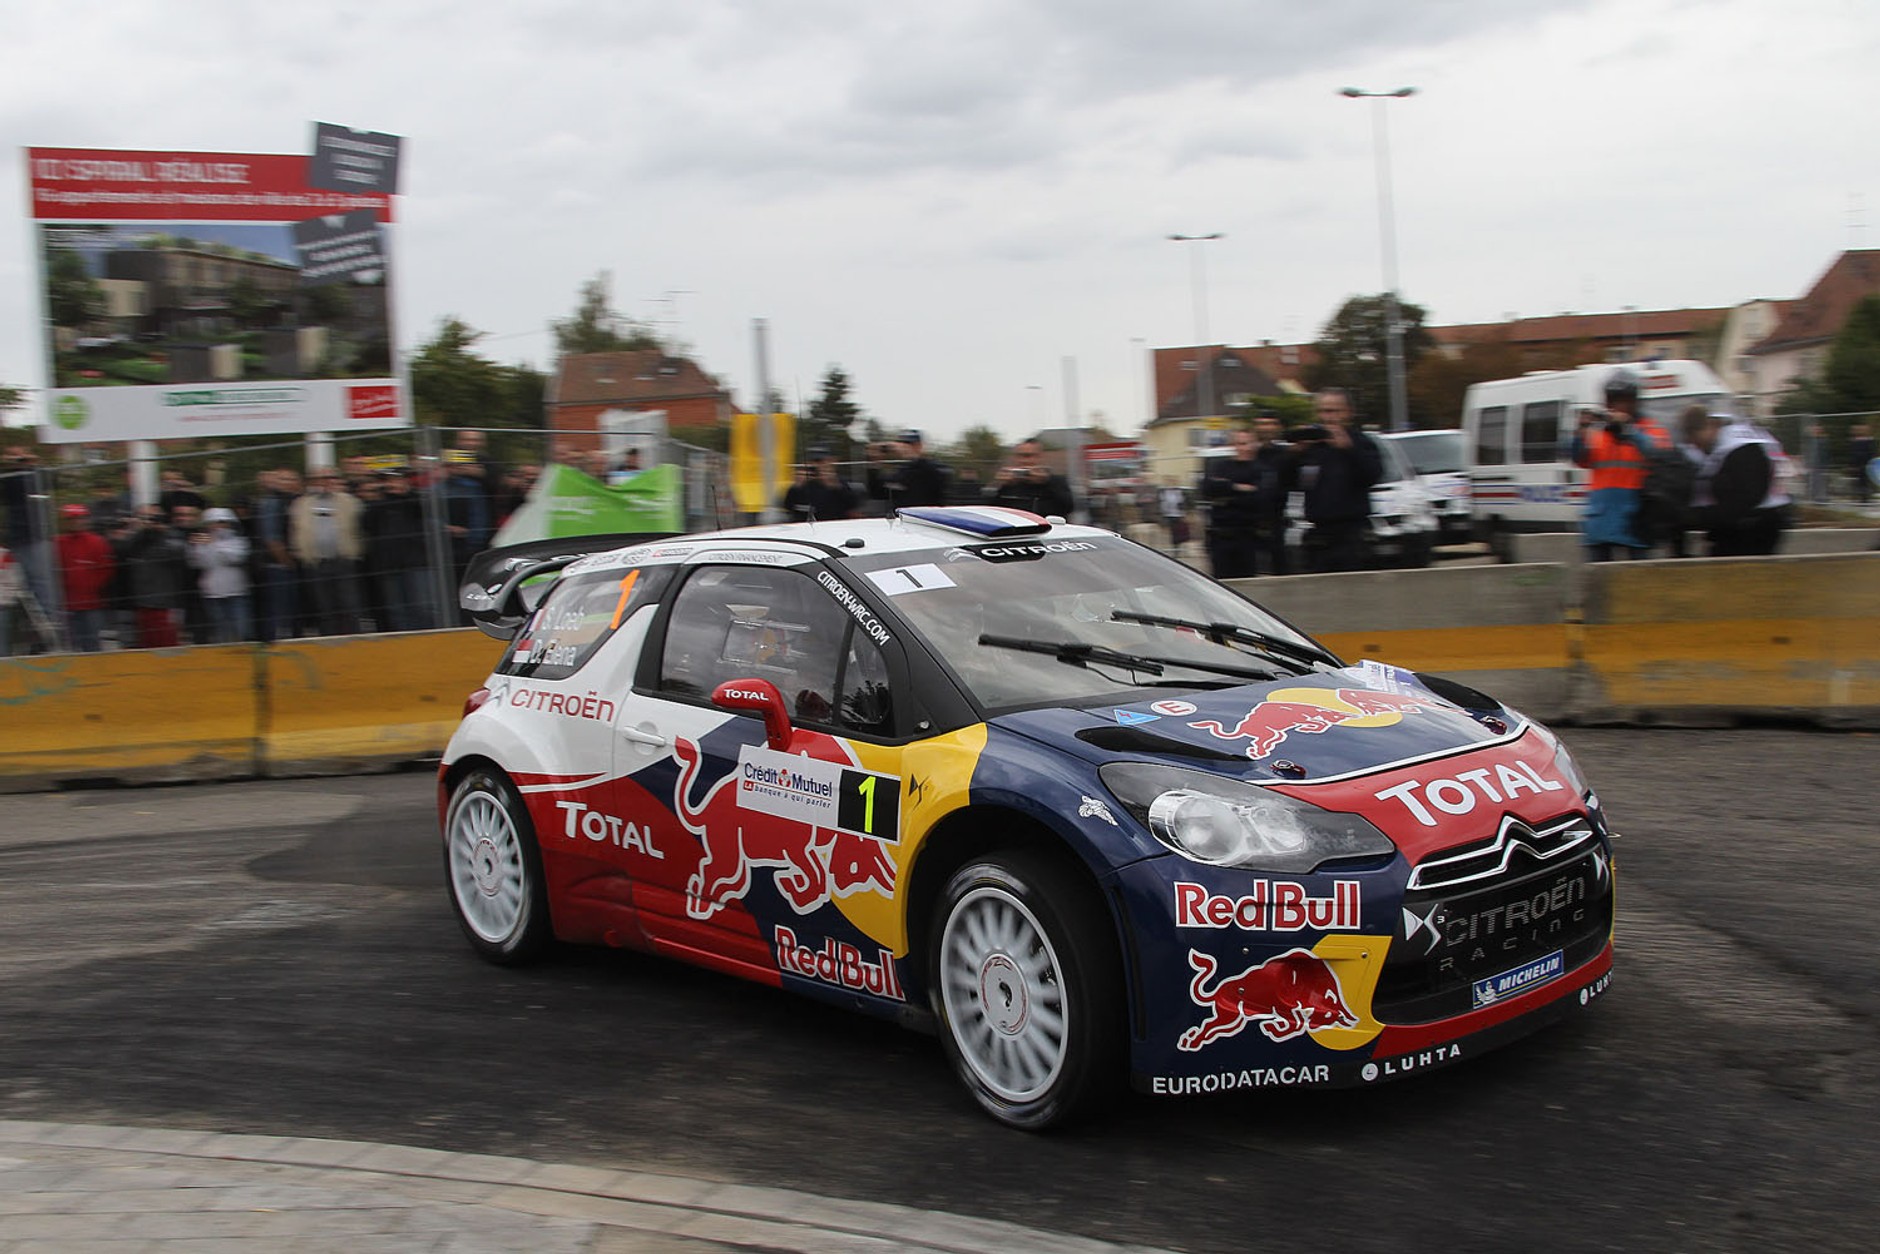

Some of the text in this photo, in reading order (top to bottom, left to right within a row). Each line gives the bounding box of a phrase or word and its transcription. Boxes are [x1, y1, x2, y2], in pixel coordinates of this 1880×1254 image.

[609, 569, 640, 630] 1
[896, 569, 925, 589] 1
[817, 571, 891, 646] CITROEN-WRC.COM
[724, 689, 769, 701] TOTAL
[744, 762, 832, 797] Crédit Mutuel
[754, 785, 780, 796] banque
[806, 797, 831, 808] parler
[1375, 760, 1563, 827] TOTAL
[858, 775, 876, 833] 1
[556, 801, 664, 861] TOTAL
[1173, 879, 1361, 931] Red Bull
[775, 924, 907, 1001] Red Bull
[1499, 957, 1560, 992] MICHELIN
[1151, 1064, 1330, 1095] EURODATACAR
[1384, 1044, 1461, 1076] LUHTA
